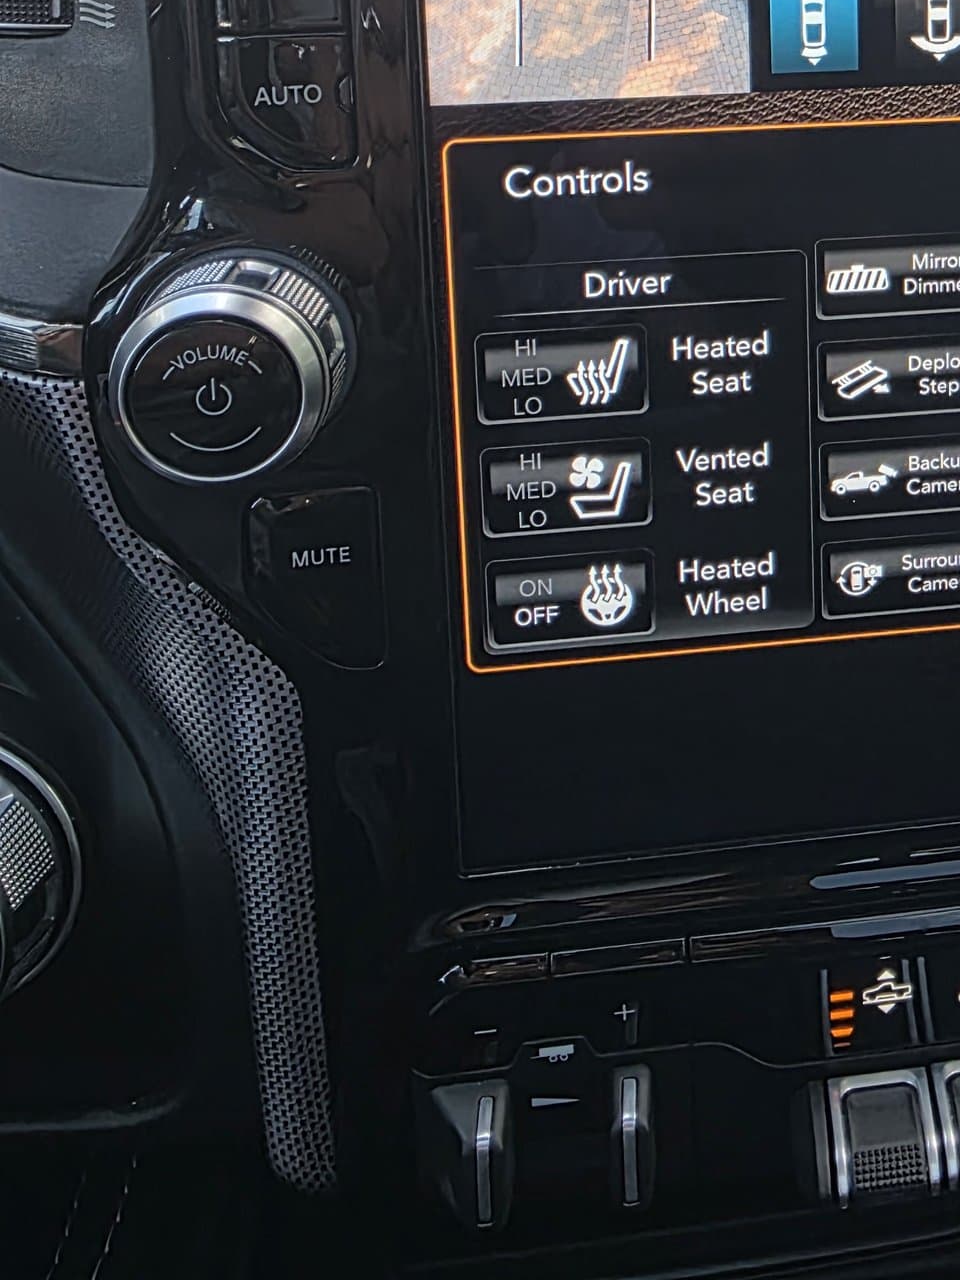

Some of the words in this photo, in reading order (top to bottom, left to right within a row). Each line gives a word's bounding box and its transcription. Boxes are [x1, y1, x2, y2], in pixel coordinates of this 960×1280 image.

[254, 84, 323, 107] AUTO
[504, 160, 650, 198] Controls
[584, 271, 673, 299] Driver
[514, 338, 537, 358] HI
[671, 329, 771, 362] Heated
[169, 343, 250, 372] VOLUME
[500, 367, 552, 389] MED
[691, 370, 753, 397] Seat
[918, 377, 960, 399] Step
[513, 396, 543, 417] LO
[519, 452, 542, 472] HI
[676, 440, 772, 473] Vented
[505, 480, 557, 502] MED
[695, 481, 755, 507] Seat
[518, 509, 548, 530] LO
[291, 546, 351, 569] MUTE
[678, 550, 776, 585] Heated
[518, 578, 553, 597] ON
[685, 586, 769, 617] Wheel
[514, 604, 560, 627] OFF
